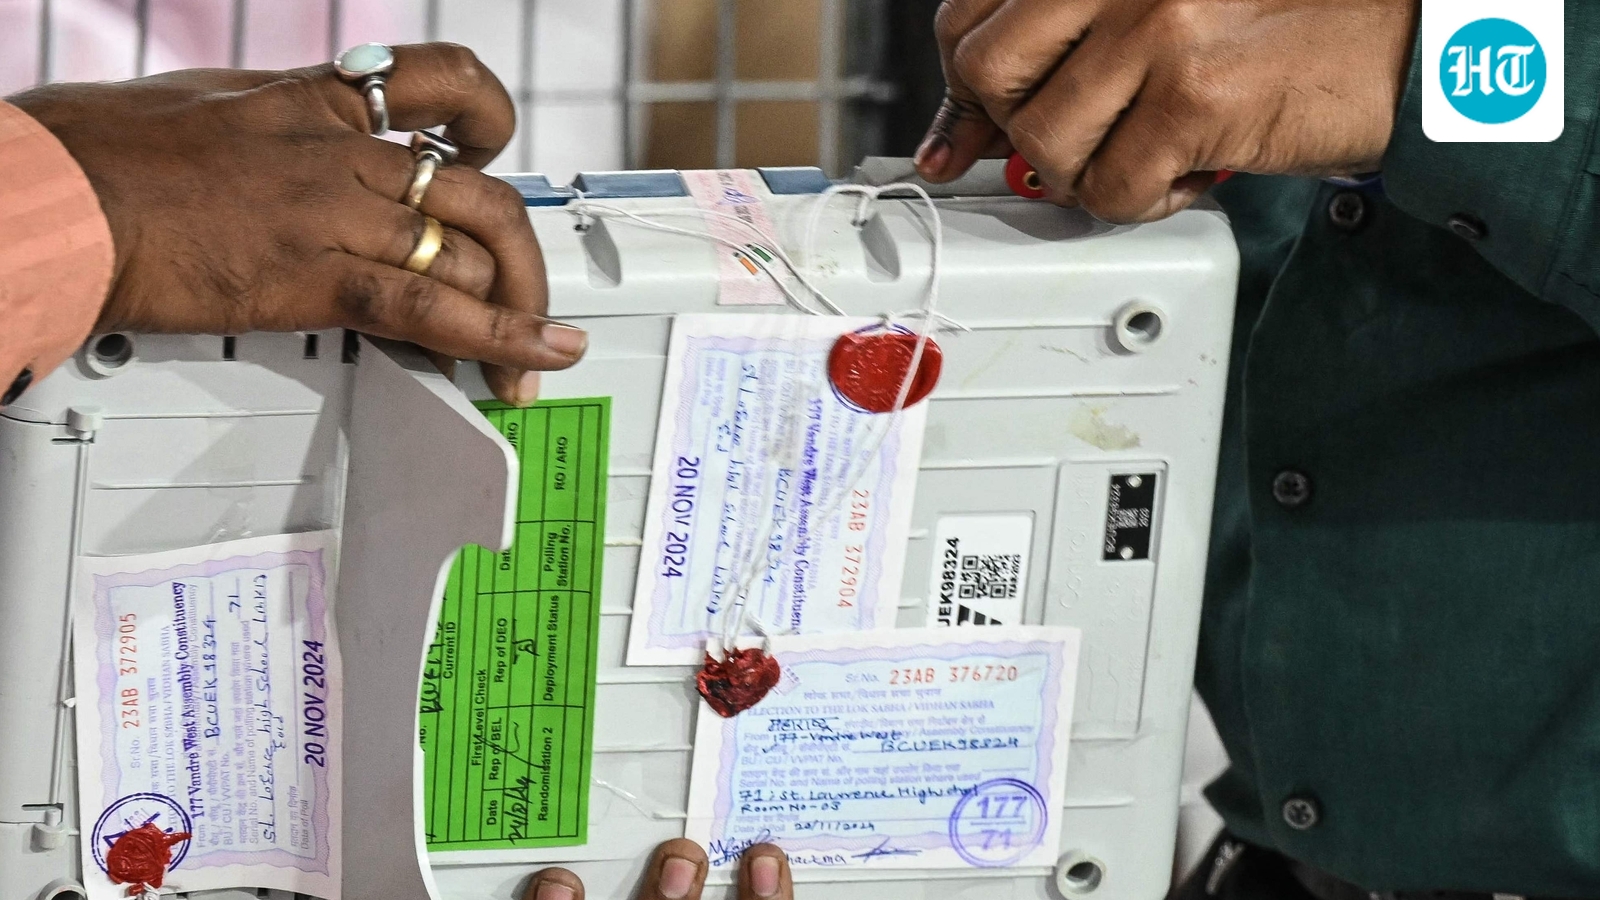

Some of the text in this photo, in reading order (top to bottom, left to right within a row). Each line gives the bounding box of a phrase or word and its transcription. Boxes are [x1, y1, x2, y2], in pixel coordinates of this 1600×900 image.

[555, 437, 568, 464] ARO
[555, 473, 566, 491] RO
[662, 457, 701, 577] 20 NOV 2024
[847, 490, 869, 531] 23AB
[544, 532, 558, 572] Polling
[556, 524, 571, 587] Station No.
[837, 544, 863, 607] 372904
[171, 581, 189, 660] Constituency
[119, 613, 137, 676] 372905
[161, 626, 171, 657] SABHA
[442, 622, 456, 679] Current ID
[494, 618, 508, 683] Rep of DEO
[542, 595, 560, 701] Deployment Status
[162, 660, 172, 698] VIDHAN
[177, 663, 196, 718] Assembly
[889, 668, 935, 685] 23AB
[949, 665, 1018, 683] 376720
[121, 688, 139, 729] 23AB
[302, 640, 324, 767] 20 NOV 2024
[471, 669, 486, 766] First Level Check
[182, 721, 196, 752] West
[491, 718, 502, 740] BEL
[165, 739, 175, 760] LOK
[245, 750, 256, 777] Name
[166, 762, 175, 785] THE
[185, 752, 201, 796] Vandre
[489, 758, 501, 780] Rep
[538, 737, 553, 821] Randomisation
[247, 780, 257, 796] and
[190, 798, 204, 819] 177
[300, 799, 308, 815] Poll
[486, 800, 497, 825] Date
[977, 796, 1027, 819] 177
[249, 818, 259, 844] Serial
[301, 826, 309, 849] Date
[981, 829, 1012, 850] 71
